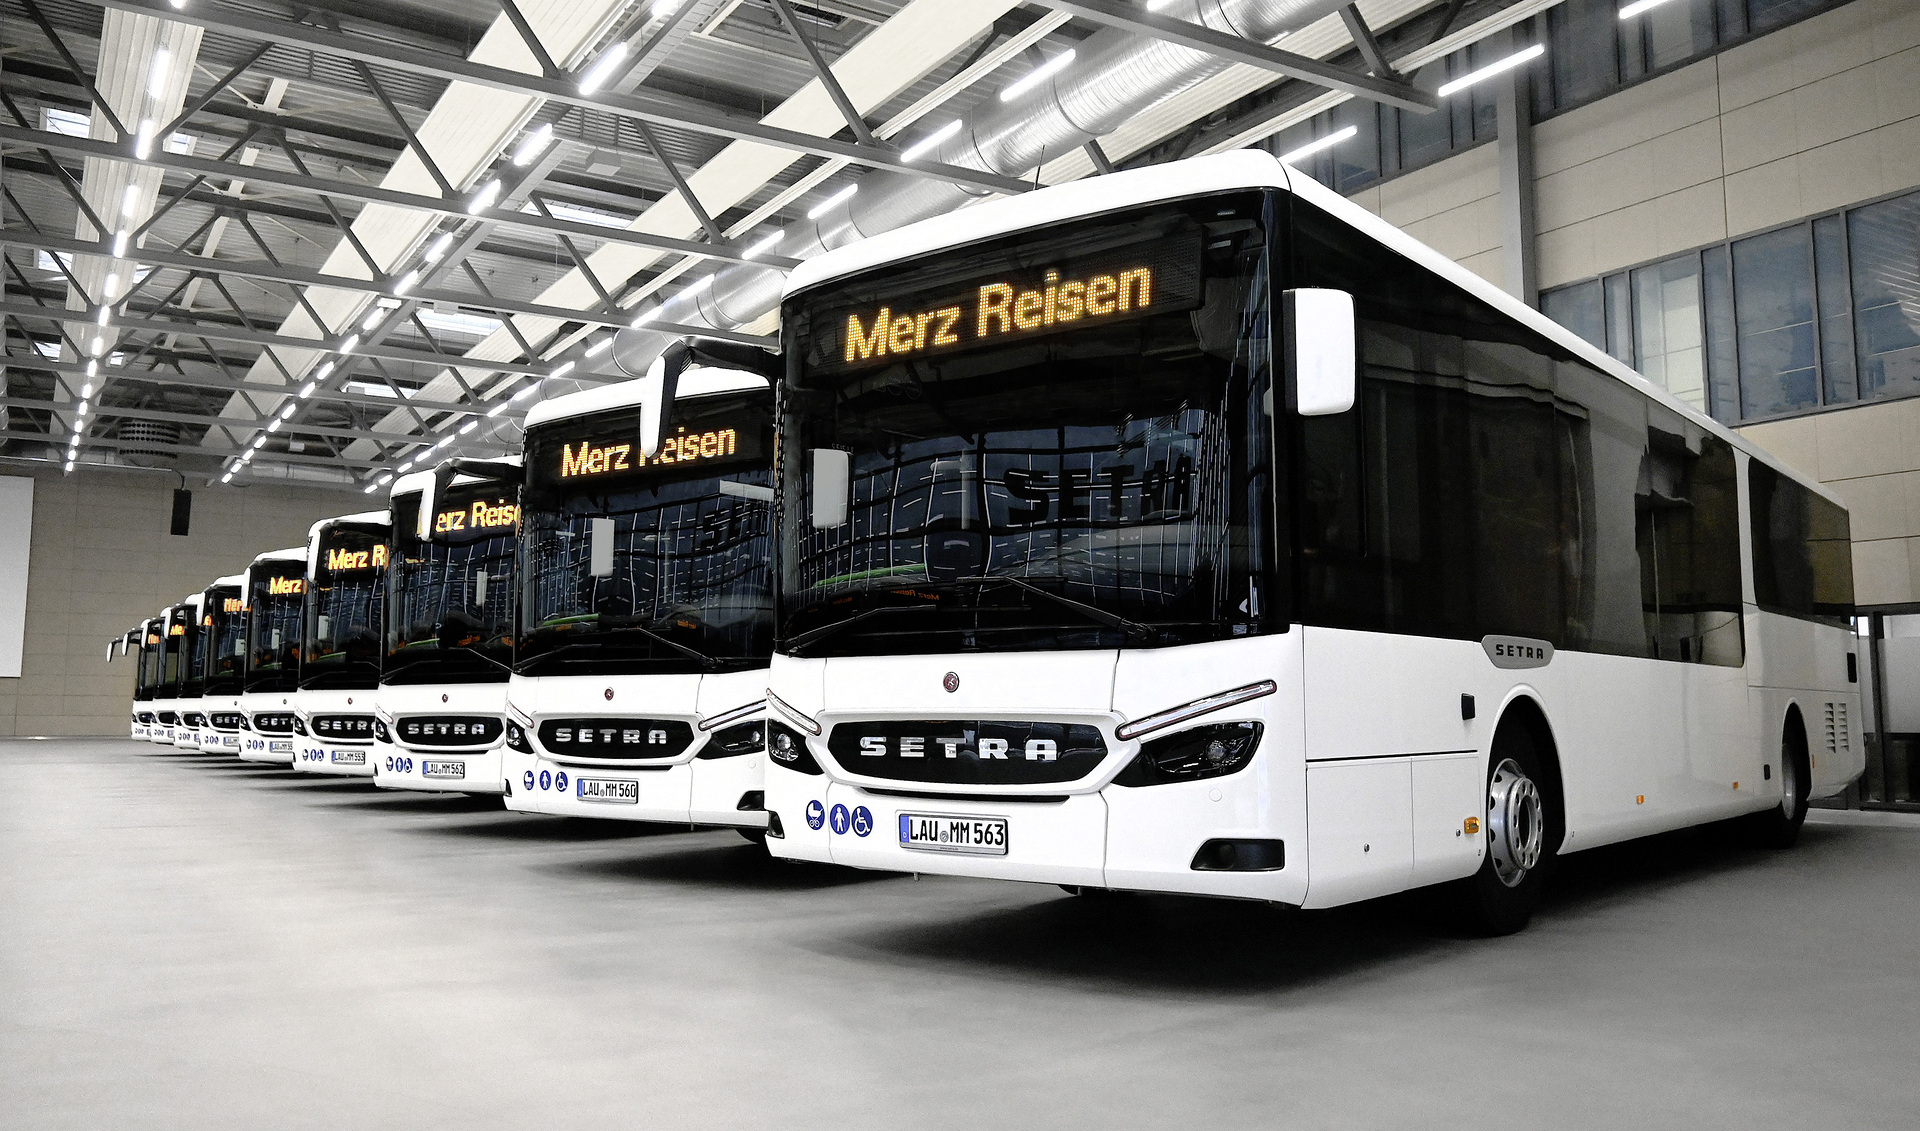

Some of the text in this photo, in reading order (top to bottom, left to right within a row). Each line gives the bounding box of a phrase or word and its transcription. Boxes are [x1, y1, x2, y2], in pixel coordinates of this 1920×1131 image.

[846, 267, 1151, 361] Merz Reisen
[561, 441, 630, 477] Merz
[417, 508, 466, 534] erz
[328, 548, 369, 570] Merz
[269, 576, 303, 595] Merz
[224, 598, 251, 612] Mer
[1495, 643, 1544, 659] SETRA
[260, 717, 294, 726] SET
[407, 723, 485, 735] SETRA
[555, 728, 667, 744] SETRA
[860, 736, 1057, 761] SETRA
[427, 763, 438, 774] LAU
[451, 763, 463, 775] 562
[583, 781, 636, 798] LAU MM 560
[909, 819, 938, 841] LAU
[950, 821, 969, 843] MM
[974, 822, 1004, 846] 563
